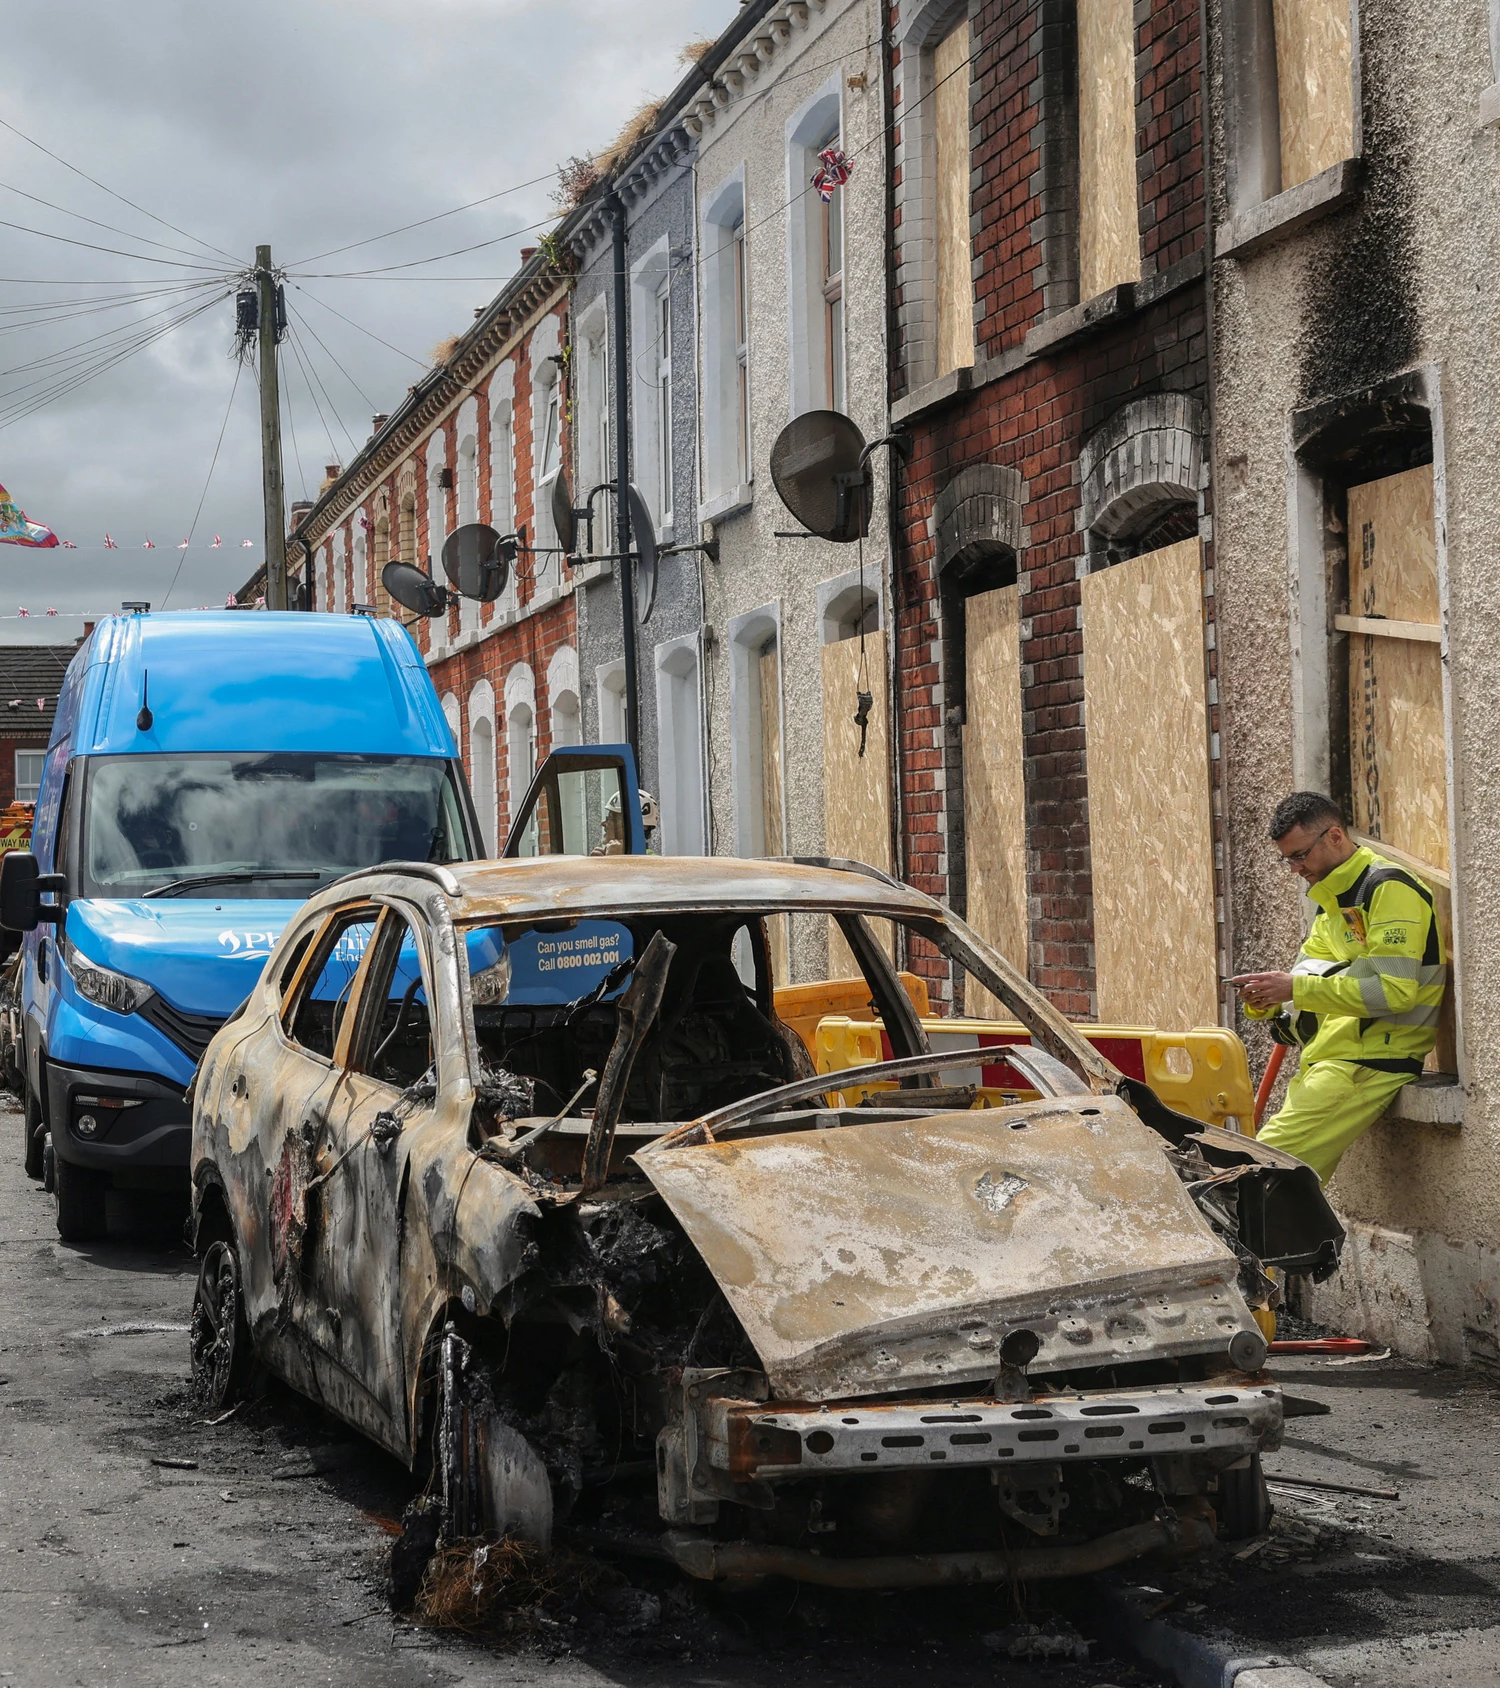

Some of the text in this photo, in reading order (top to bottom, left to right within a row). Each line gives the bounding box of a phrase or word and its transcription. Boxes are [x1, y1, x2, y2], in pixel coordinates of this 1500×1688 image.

[18, 838, 30, 848] MA
[244, 931, 372, 950] Phni
[537, 933, 620, 955] Can you smell gas?
[335, 951, 364, 962] Ene
[538, 950, 619, 972] Call 0800 002 001
